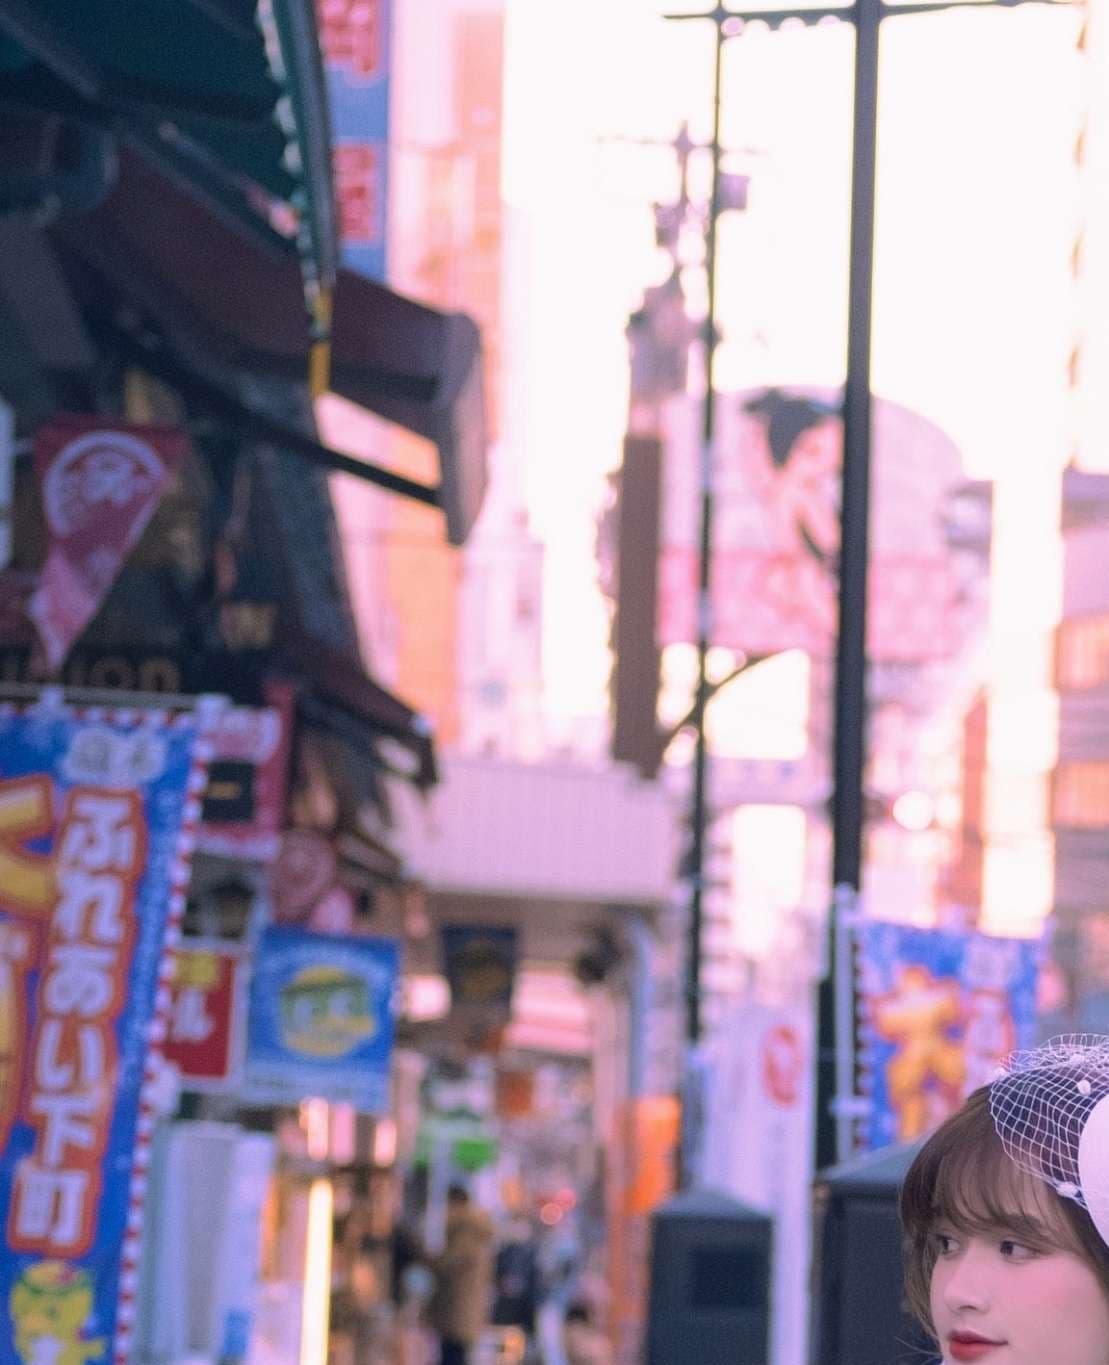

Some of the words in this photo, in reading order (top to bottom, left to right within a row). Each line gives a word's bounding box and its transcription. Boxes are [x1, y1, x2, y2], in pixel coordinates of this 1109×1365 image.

[16, 798, 138, 1244] ふれあい下町
